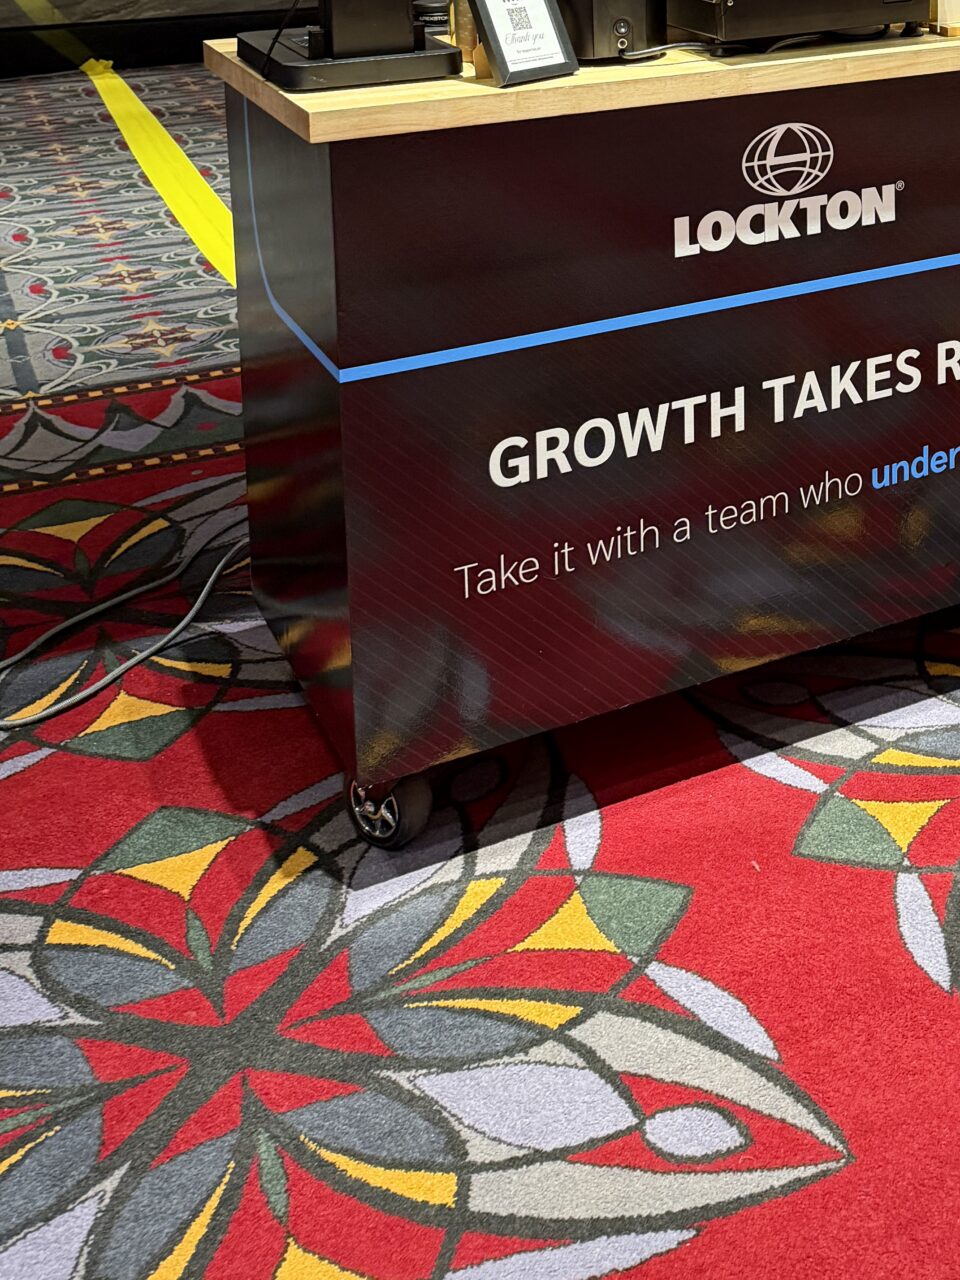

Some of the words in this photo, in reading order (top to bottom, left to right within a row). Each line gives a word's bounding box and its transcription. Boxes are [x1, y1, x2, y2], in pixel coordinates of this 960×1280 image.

[488, 386, 746, 488] GROWTH
[761, 348, 922, 423] TAKES
[454, 554, 540, 599] Take
[551, 541, 575, 575] it
[587, 518, 660, 565] with
[672, 516, 691, 543] a
[705, 490, 790, 534] team
[799, 470, 863, 509] who
